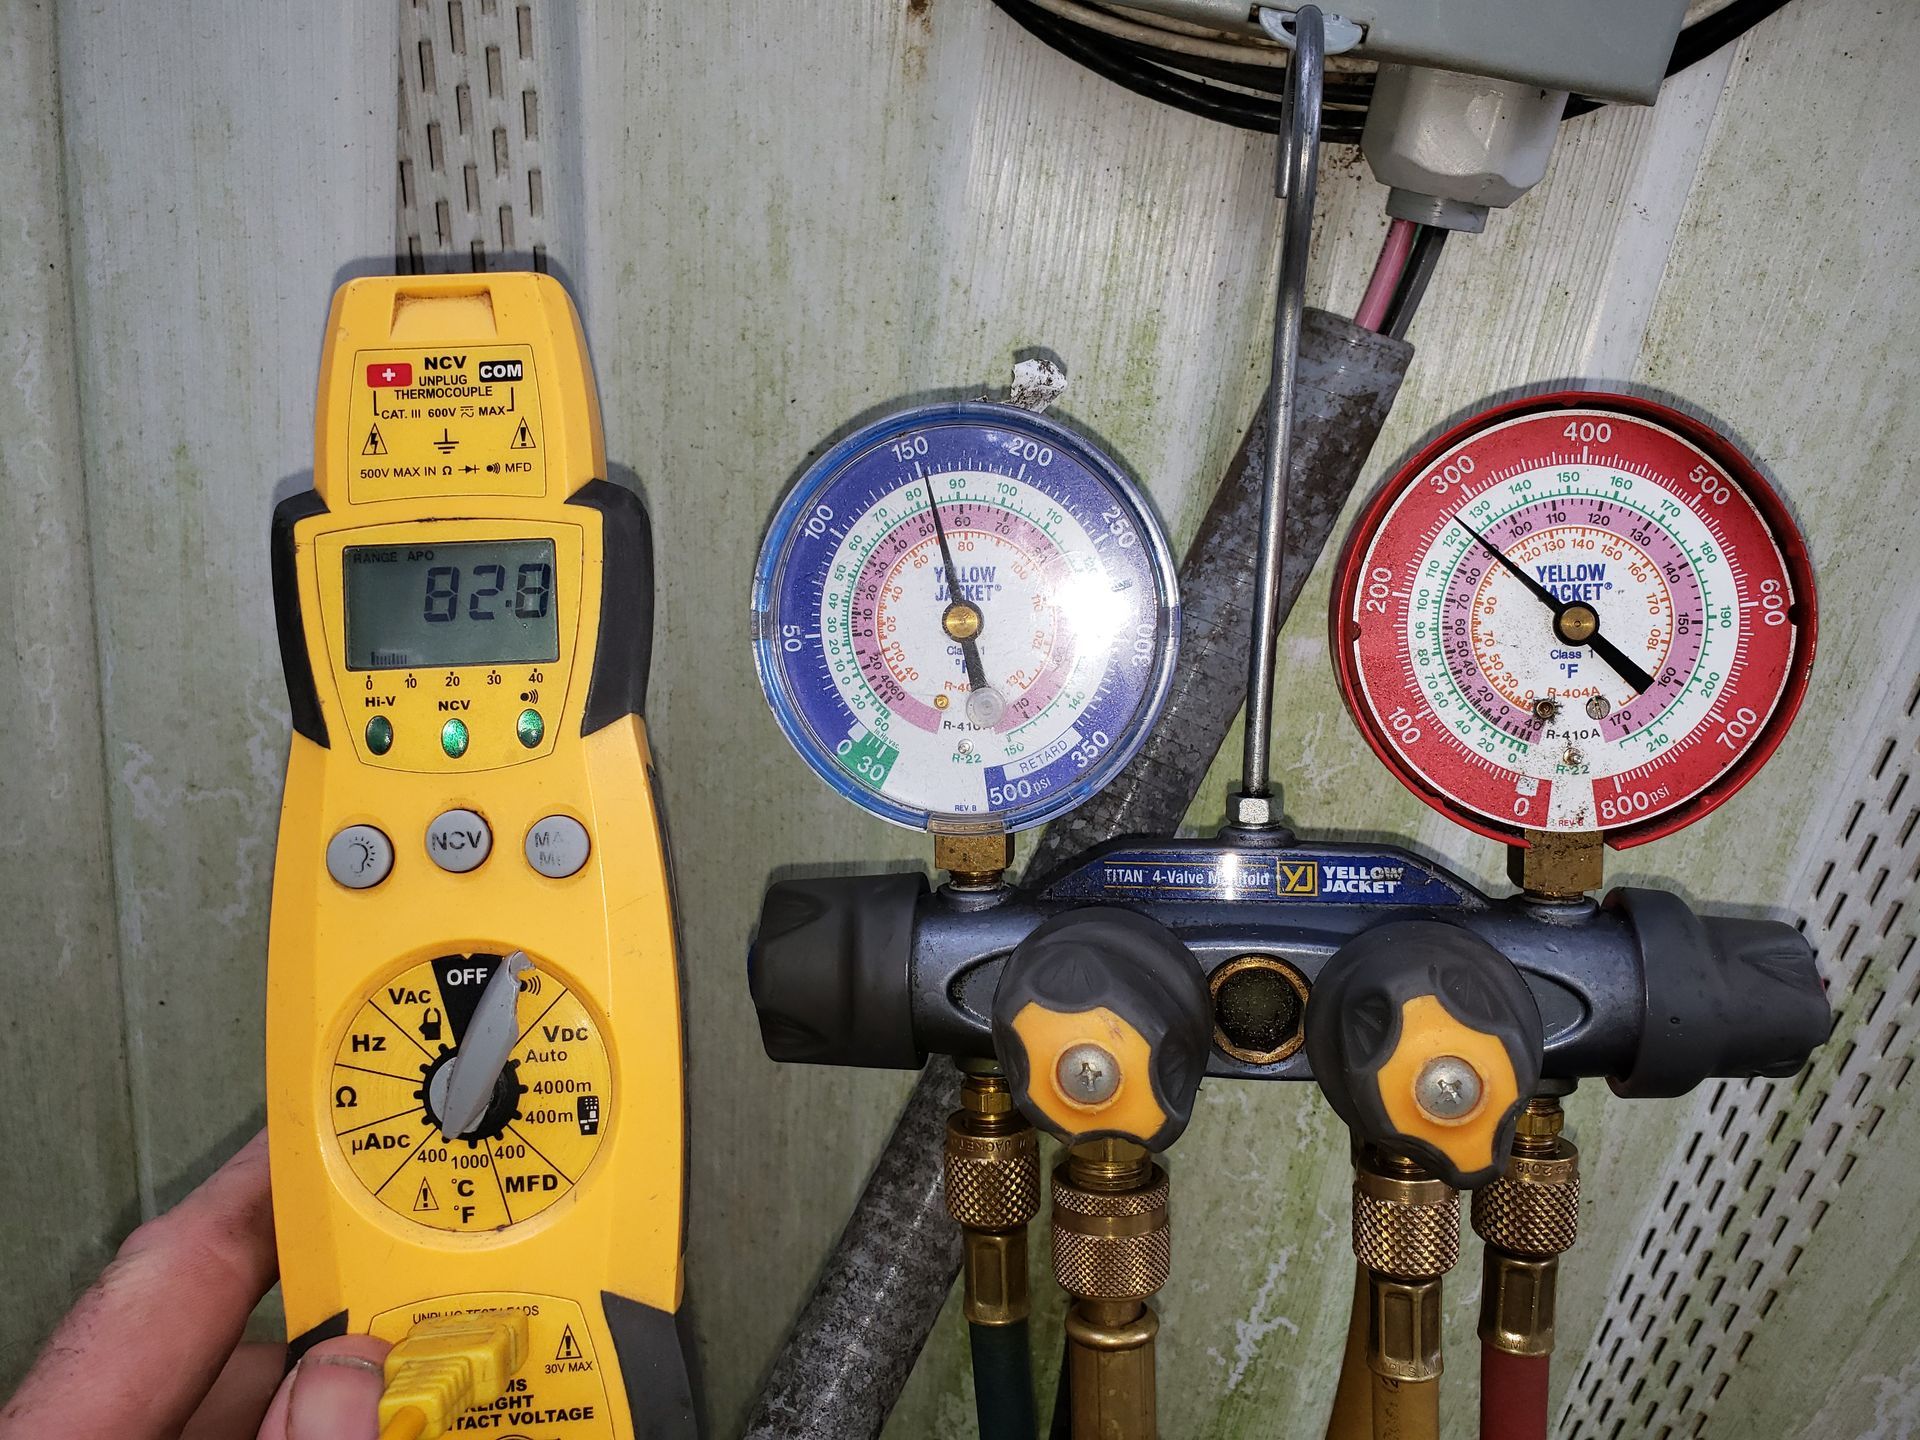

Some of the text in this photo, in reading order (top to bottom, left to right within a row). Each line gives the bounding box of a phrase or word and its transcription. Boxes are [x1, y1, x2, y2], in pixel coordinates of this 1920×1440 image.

[424, 356, 467, 370] NCV
[480, 365, 522, 378] COM
[419, 375, 467, 386] UNPLUG
[394, 386, 493, 400] THERMOCOUPLE
[381, 410, 408, 419] CAT.
[428, 408, 456, 417] 600V
[479, 406, 505, 416] MAX
[1563, 421, 1611, 443] 400
[892, 436, 928, 463] 150
[1008, 439, 1053, 467] 200
[360, 462, 532, 479] 500V MAX IN MFD
[1430, 455, 1475, 494] 300
[1557, 471, 1580, 483] 150
[949, 478, 966, 489] 90
[997, 482, 1018, 497] 100
[1508, 479, 1532, 496] 140
[1610, 475, 1633, 491] 160
[1688, 464, 1731, 505] 500
[905, 487, 922, 501] 80
[873, 507, 887, 521] 70
[1046, 507, 1063, 525] 110
[1468, 500, 1491, 519] 130
[1660, 499, 1681, 518] 170
[805, 504, 834, 540] 100
[955, 516, 971, 527] 60
[1546, 511, 1567, 525] 110
[1587, 512, 1611, 526] 120
[919, 524, 935, 537] 50
[994, 522, 1010, 535] 70
[1102, 506, 1136, 549] 250
[1509, 520, 1533, 539] 100
[849, 535, 863, 551] 60
[1442, 527, 1461, 549] 120
[1543, 538, 1566, 553] 130
[1571, 538, 1595, 551] 140
[1629, 527, 1651, 547] 130
[893, 540, 908, 554] 40
[1519, 546, 1541, 564] 120
[1601, 544, 1623, 561] 150
[1700, 541, 1717, 564] 180
[353, 551, 434, 564] RANGE APO
[834, 564, 847, 582] 50
[875, 561, 889, 578] 30
[1425, 560, 1440, 579] 110
[1466, 567, 1481, 586] 80
[1536, 563, 1606, 583] YELLOW
[1627, 561, 1647, 583] 160
[1662, 561, 1680, 584] 140
[424, 563, 551, 623] 82.8
[866, 584, 878, 601] 20
[1366, 567, 1392, 614] 200
[829, 593, 839, 610] 40
[1417, 589, 1430, 611] 100
[1456, 594, 1470, 610] 70
[1484, 597, 1498, 615] 90
[1646, 592, 1661, 615] 170
[1760, 578, 1786, 626] 600
[863, 609, 873, 622] 10
[1678, 611, 1690, 635] 150
[1720, 604, 1732, 628] 190
[827, 616, 836, 634] 30
[863, 629, 873, 637] 0
[1415, 621, 1425, 639] 90
[1455, 618, 1466, 636] 60
[782, 624, 802, 653] 50
[828, 639, 841, 655] 20
[1131, 624, 1154, 666] 300
[1483, 631, 1495, 647] 70
[1647, 628, 1661, 651] 180
[1418, 648, 1430, 666] 80
[1456, 640, 1469, 658] 50
[1550, 649, 1594, 659] Class 1
[834, 659, 845, 673] 10
[869, 654, 883, 670] 20
[1462, 660, 1477, 677] 40
[1489, 653, 1504, 671] 50
[366, 672, 543, 691] 0 10 20 30 40
[841, 676, 850, 685] 0
[881, 674, 894, 689] 40
[1424, 673, 1439, 690] 70
[1501, 672, 1519, 689] 30
[1657, 666, 1677, 688] 160
[1700, 671, 1720, 699] 200
[1433, 691, 1449, 709] 60
[1477, 685, 1494, 702] 20
[1525, 690, 1534, 700] 0
[1547, 686, 1600, 698] R-404A
[365, 696, 396, 707] Hi-V
[438, 700, 471, 711] NCV
[851, 694, 866, 710] 20
[1500, 705, 1510, 716] 0
[1609, 710, 1632, 727] 170
[874, 717, 889, 732] 60
[1388, 706, 1421, 745] 100
[1454, 718, 1471, 735] 40
[1524, 718, 1544, 731] 40
[1716, 707, 1757, 750] 700
[1546, 728, 1600, 740] R-410A
[1645, 733, 1669, 752] 210
[837, 739, 853, 755] 0
[1004, 742, 1025, 756] 150
[1071, 730, 1109, 768] 350
[1477, 738, 1494, 753] 20
[952, 753, 982, 764] R-22
[1020, 740, 1068, 774] RETARD
[1508, 753, 1517, 763] 0
[856, 756, 885, 781] 30
[1556, 764, 1589, 776] R-22
[1513, 798, 1530, 817] 0
[432, 831, 482, 851] NCV
[1153, 870, 1204, 885] 4-Valve
[1208, 871, 1270, 886] Mifold
[447, 967, 488, 986] OFF
[352, 1034, 387, 1052] Hz
[525, 1049, 568, 1064] Auto
[533, 1079, 592, 1094] 4000m
[525, 1109, 573, 1124] 400m
[417, 1148, 447, 1163] 400
[495, 1145, 526, 1159] 400
[451, 1154, 489, 1169] 1000
[505, 1174, 558, 1193] MFD
[545, 1361, 593, 1374] 30V MAX
[509, 1407, 594, 1425] VOLTAGE
